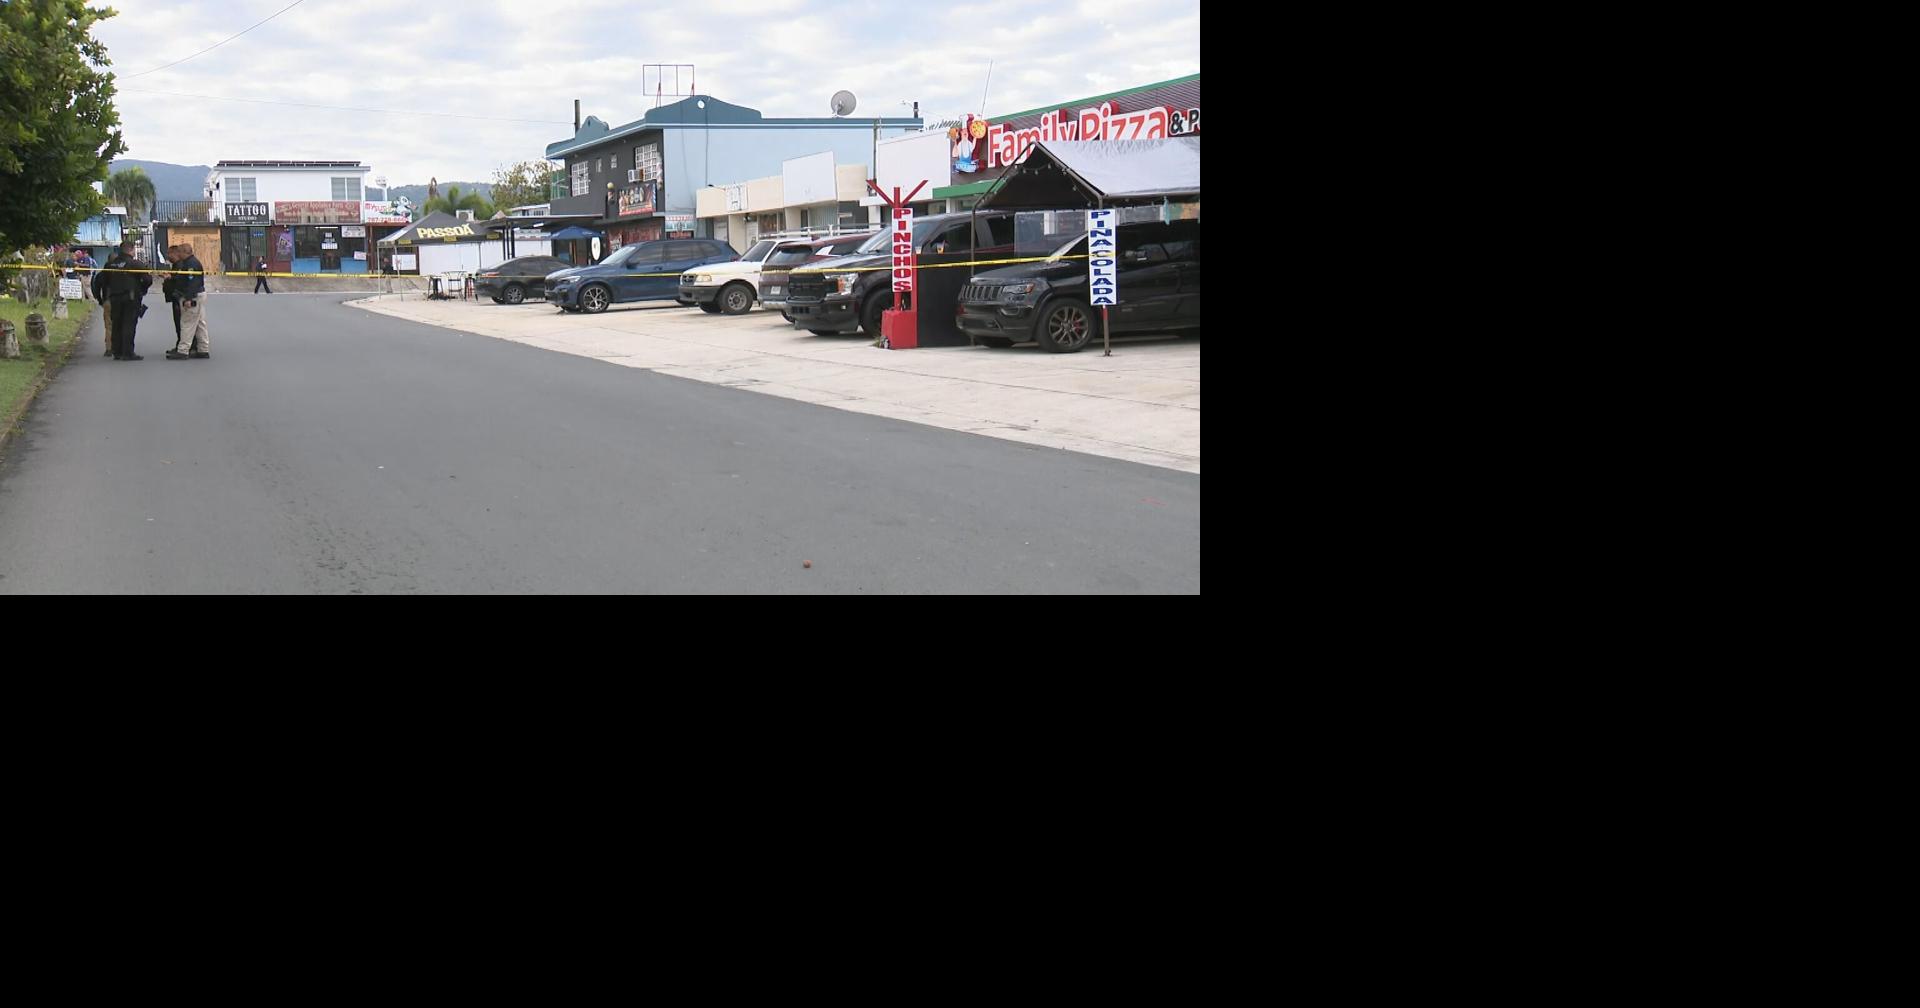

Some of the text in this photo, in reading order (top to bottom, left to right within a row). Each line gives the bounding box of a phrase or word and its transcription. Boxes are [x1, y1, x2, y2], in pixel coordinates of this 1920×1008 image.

[988, 102, 1200, 168] Family Pizza & P
[226, 204, 267, 216] TATTOO
[893, 209, 912, 291] PINCHOS
